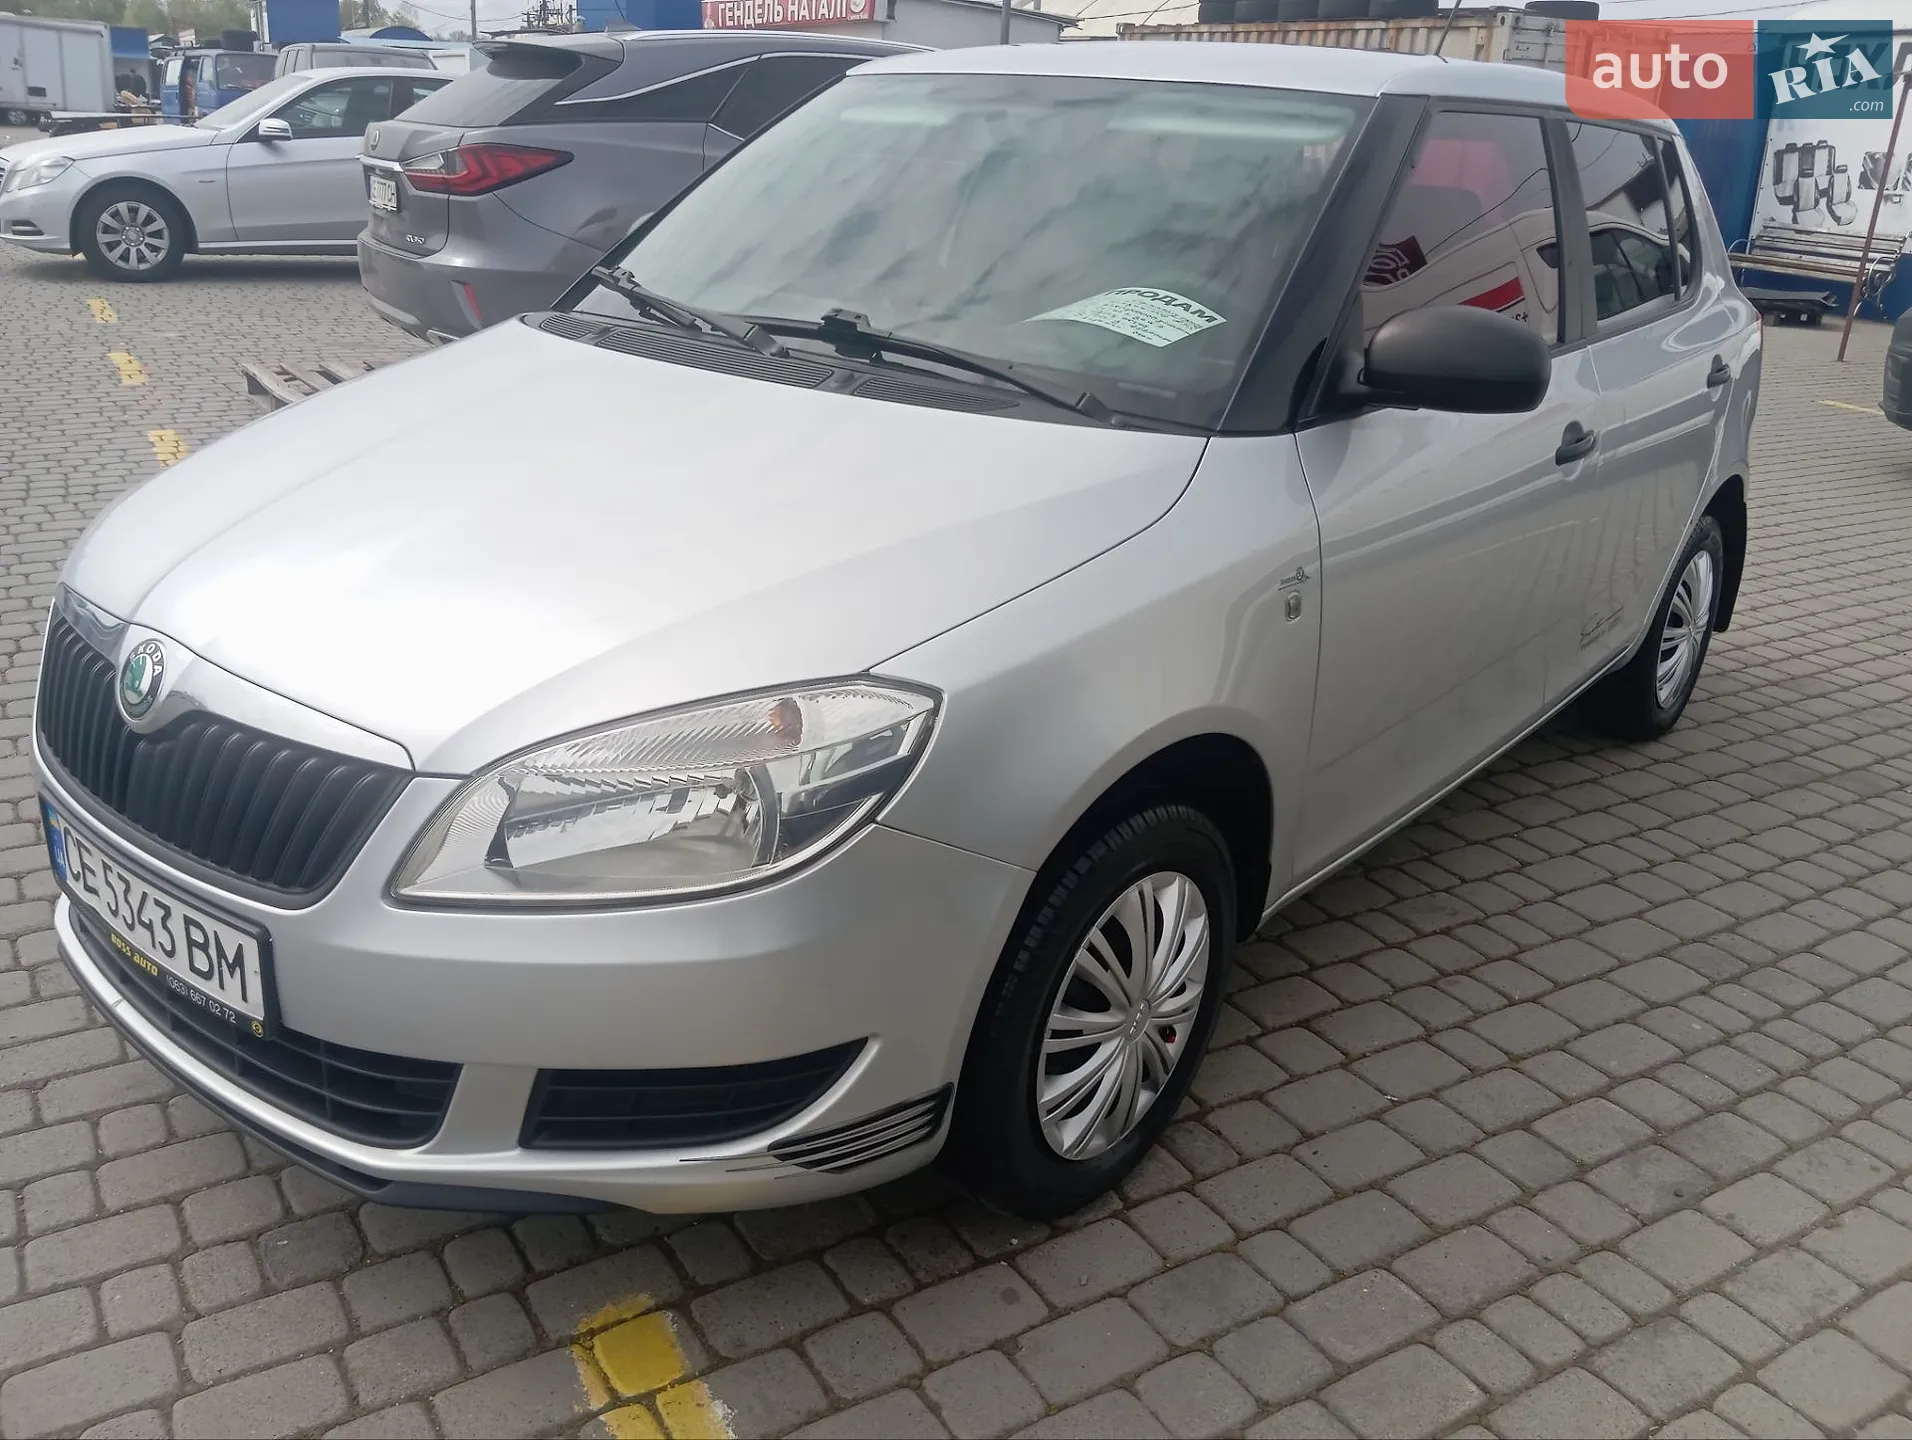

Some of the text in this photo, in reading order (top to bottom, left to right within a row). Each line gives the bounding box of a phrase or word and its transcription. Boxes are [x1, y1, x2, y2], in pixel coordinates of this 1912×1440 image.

[718, 1, 783, 28] ГЕНДЕЛЬ
[1104, 289, 1218, 323] ПРОДАМ
[64, 826, 248, 1003] CE 5343 BM
[208, 1000, 222, 1016] 02
[222, 1007, 237, 1024] 72
